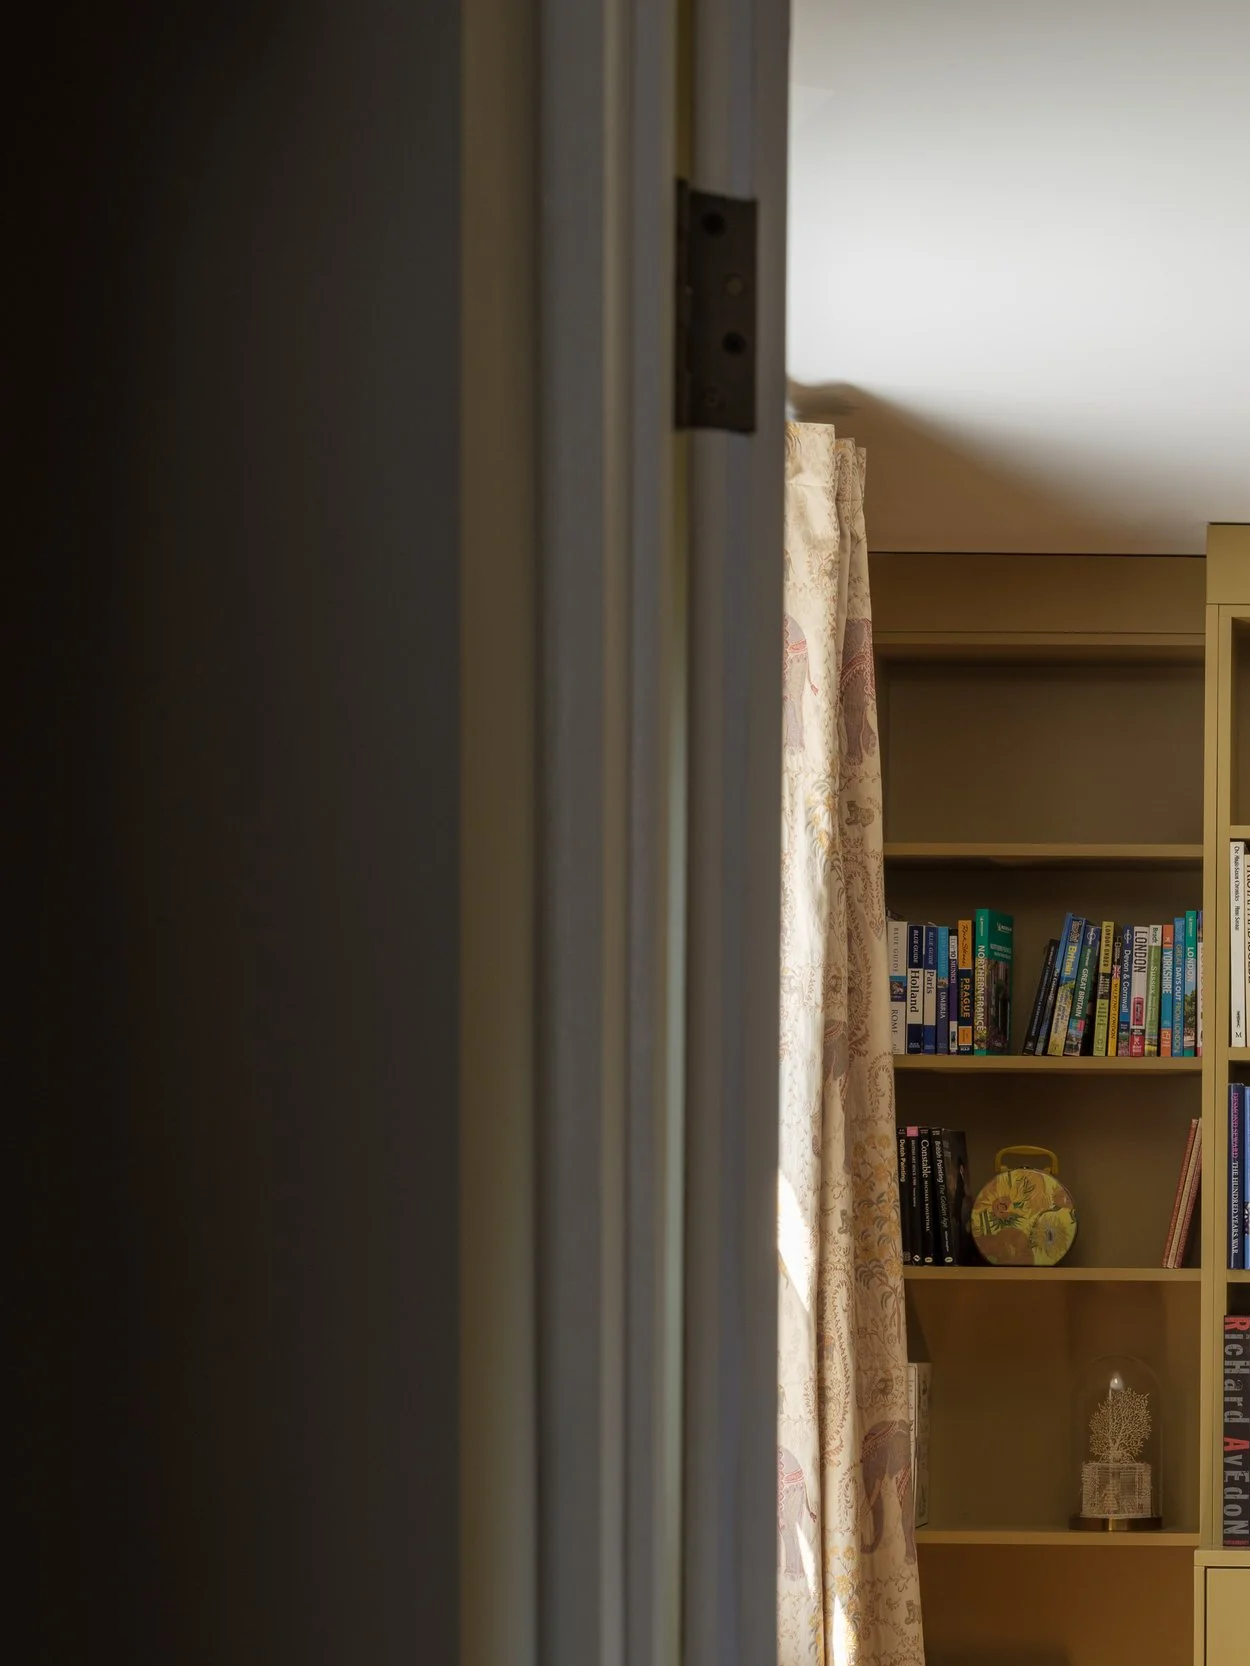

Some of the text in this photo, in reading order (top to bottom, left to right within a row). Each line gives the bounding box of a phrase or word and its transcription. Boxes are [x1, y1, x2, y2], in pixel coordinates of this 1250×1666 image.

[1064, 946, 1078, 976] Britain
[1134, 930, 1146, 972] LONDON
[1187, 947, 1195, 982] LONDON
[926, 970, 934, 994] Paris
[977, 945, 986, 995] NORTHERN
[1162, 950, 1172, 994] YORKSHIRE
[910, 970, 920, 1013] Holland
[976, 996, 985, 1031] FRANCE
[936, 1160, 944, 1183] Painting
